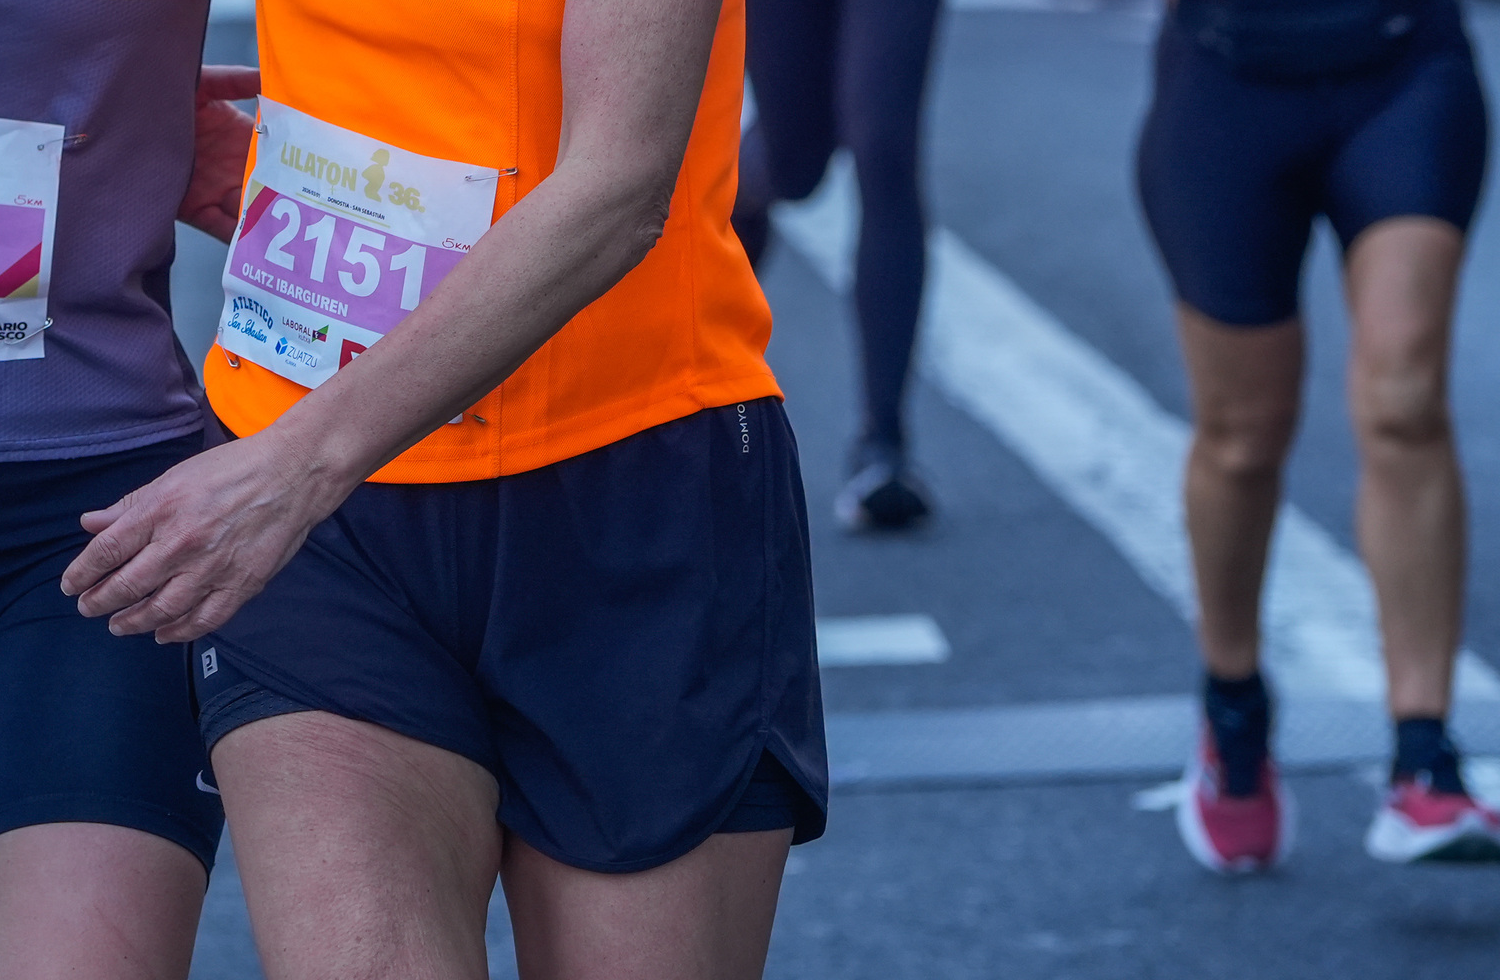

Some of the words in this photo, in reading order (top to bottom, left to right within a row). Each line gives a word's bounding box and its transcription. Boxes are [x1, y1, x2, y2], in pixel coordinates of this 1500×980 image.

[279, 140, 359, 192] LILATON
[387, 181, 427, 214] 36.
[327, 196, 351, 210] DONOSTIA
[352, 203, 363, 214] SAN
[263, 197, 428, 312] 2151
[241, 261, 276, 289] OLATZ
[275, 277, 350, 318] IBARGUREN
[227, 312, 242, 331] San
[232, 295, 274, 330] ATLETICO
[281, 316, 312, 338] LABORAL
[286, 344, 319, 369] ZUATZU
